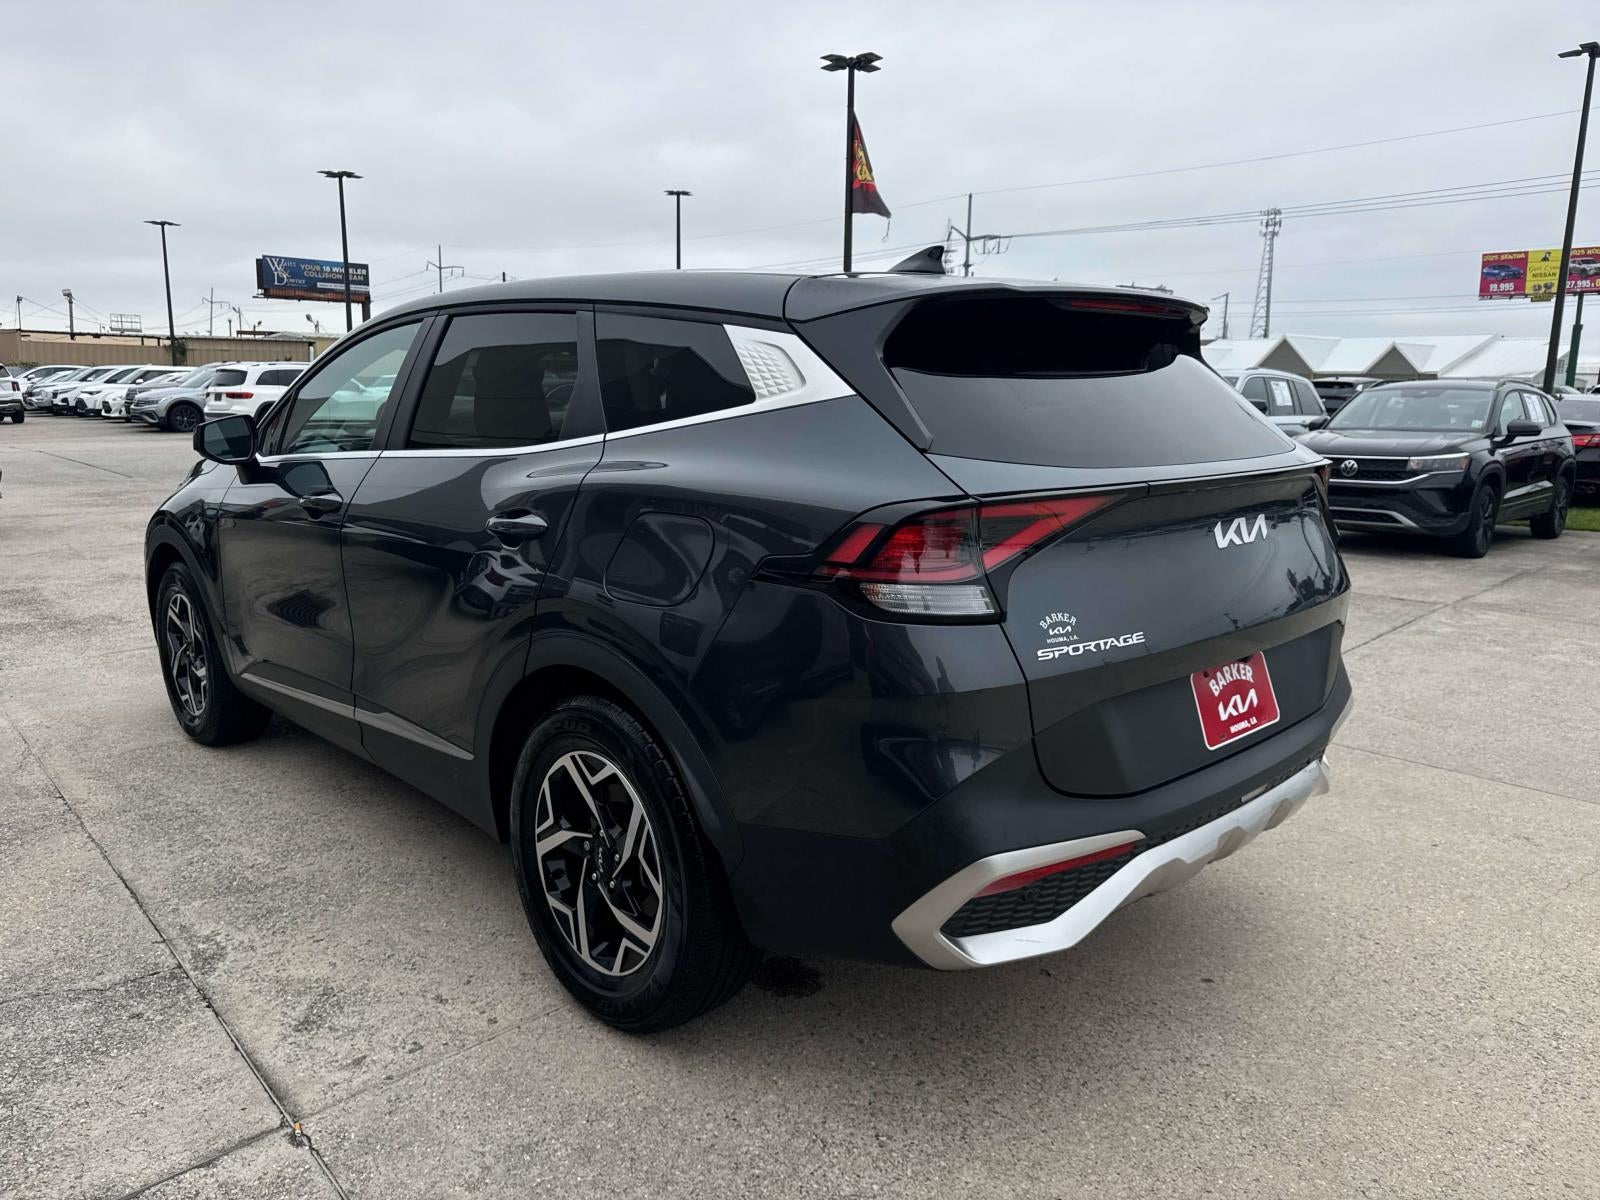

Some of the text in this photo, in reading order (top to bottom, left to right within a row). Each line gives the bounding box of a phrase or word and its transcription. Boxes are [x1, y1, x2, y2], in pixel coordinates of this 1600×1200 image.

[300, 263, 320, 272] YOUR
[332, 267, 367, 276] WHELER
[304, 271, 343, 280] COLLISION
[1213, 513, 1268, 549] KIA
[1040, 612, 1077, 630] BARKER
[1048, 625, 1072, 636] KIA
[1037, 631, 1146, 661] SPORTAGE
[1046, 636, 1069, 644] HOUMA,
[1208, 662, 1255, 697] BARKER
[1217, 687, 1259, 722] KIA
